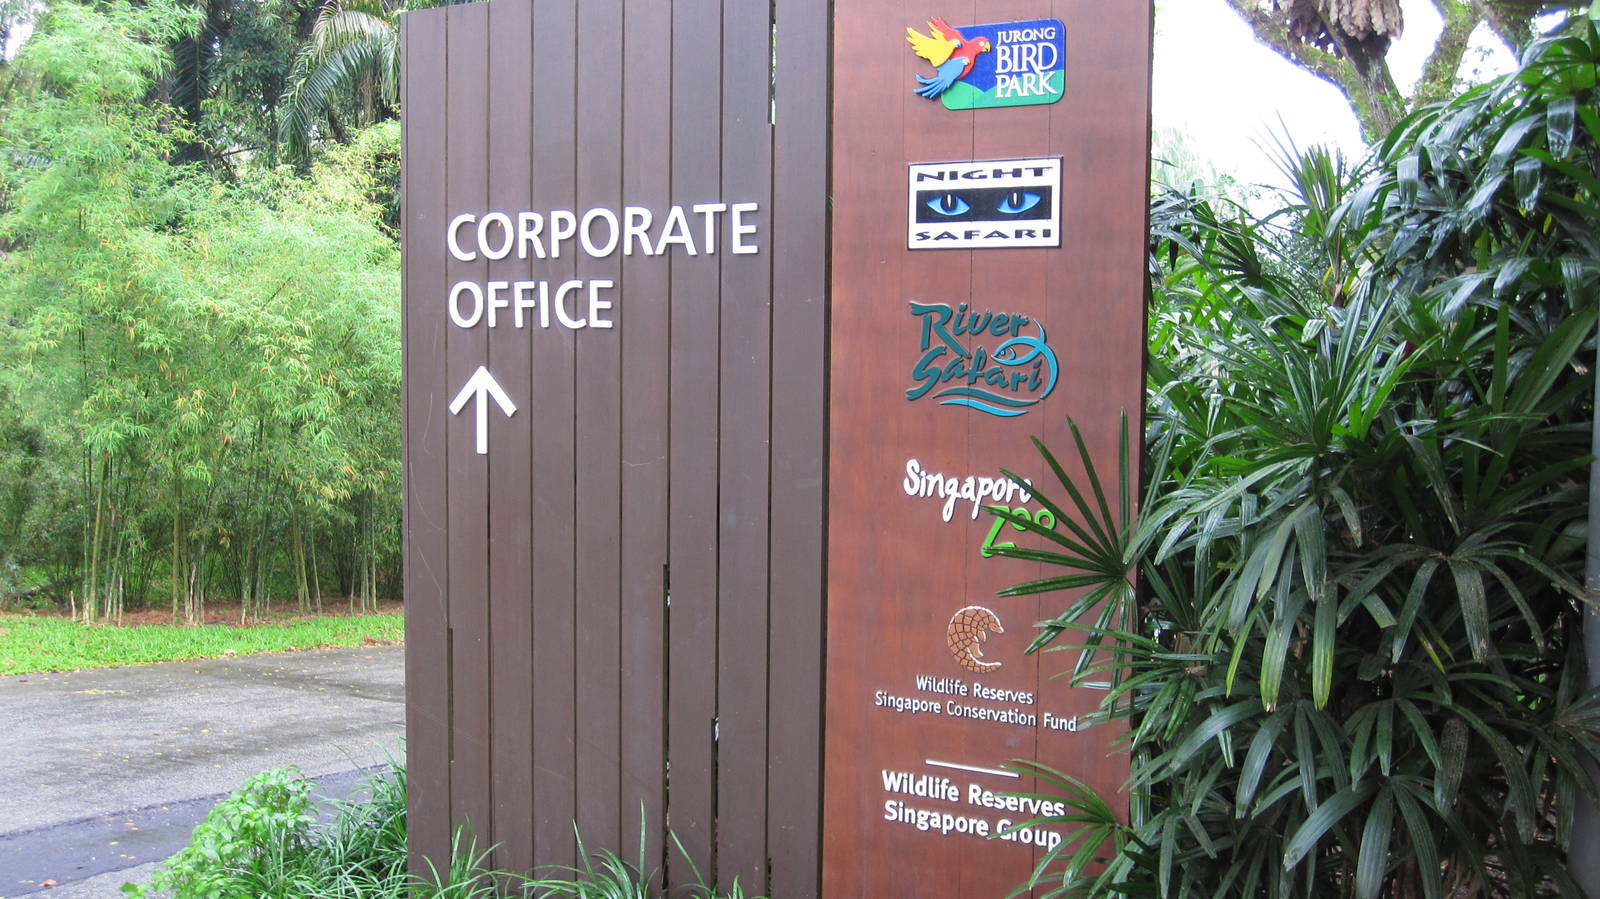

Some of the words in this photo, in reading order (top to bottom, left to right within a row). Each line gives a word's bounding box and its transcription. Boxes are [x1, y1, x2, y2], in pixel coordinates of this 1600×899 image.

[997, 27, 1056, 46] JURONG
[995, 42, 1058, 74] BIRD
[995, 72, 1058, 98] PARK
[917, 166, 1053, 182] NIGHT
[447, 202, 759, 261] CORPORATE
[915, 229, 1052, 241] SAFARI
[448, 280, 614, 329] OFFICE
[908, 300, 1030, 359] River
[905, 346, 1043, 401] Safari
[916, 675, 968, 697] Wildlife
[973, 682, 1034, 705] Reserves
[875, 691, 942, 714] Singapore
[946, 700, 1037, 727] Conservation
[1043, 712, 1078, 732] Fund
[881, 769, 961, 802] Wildlife
[968, 783, 1066, 818] Reserves
[884, 800, 990, 835] Singapore
[996, 818, 1062, 853] Group
